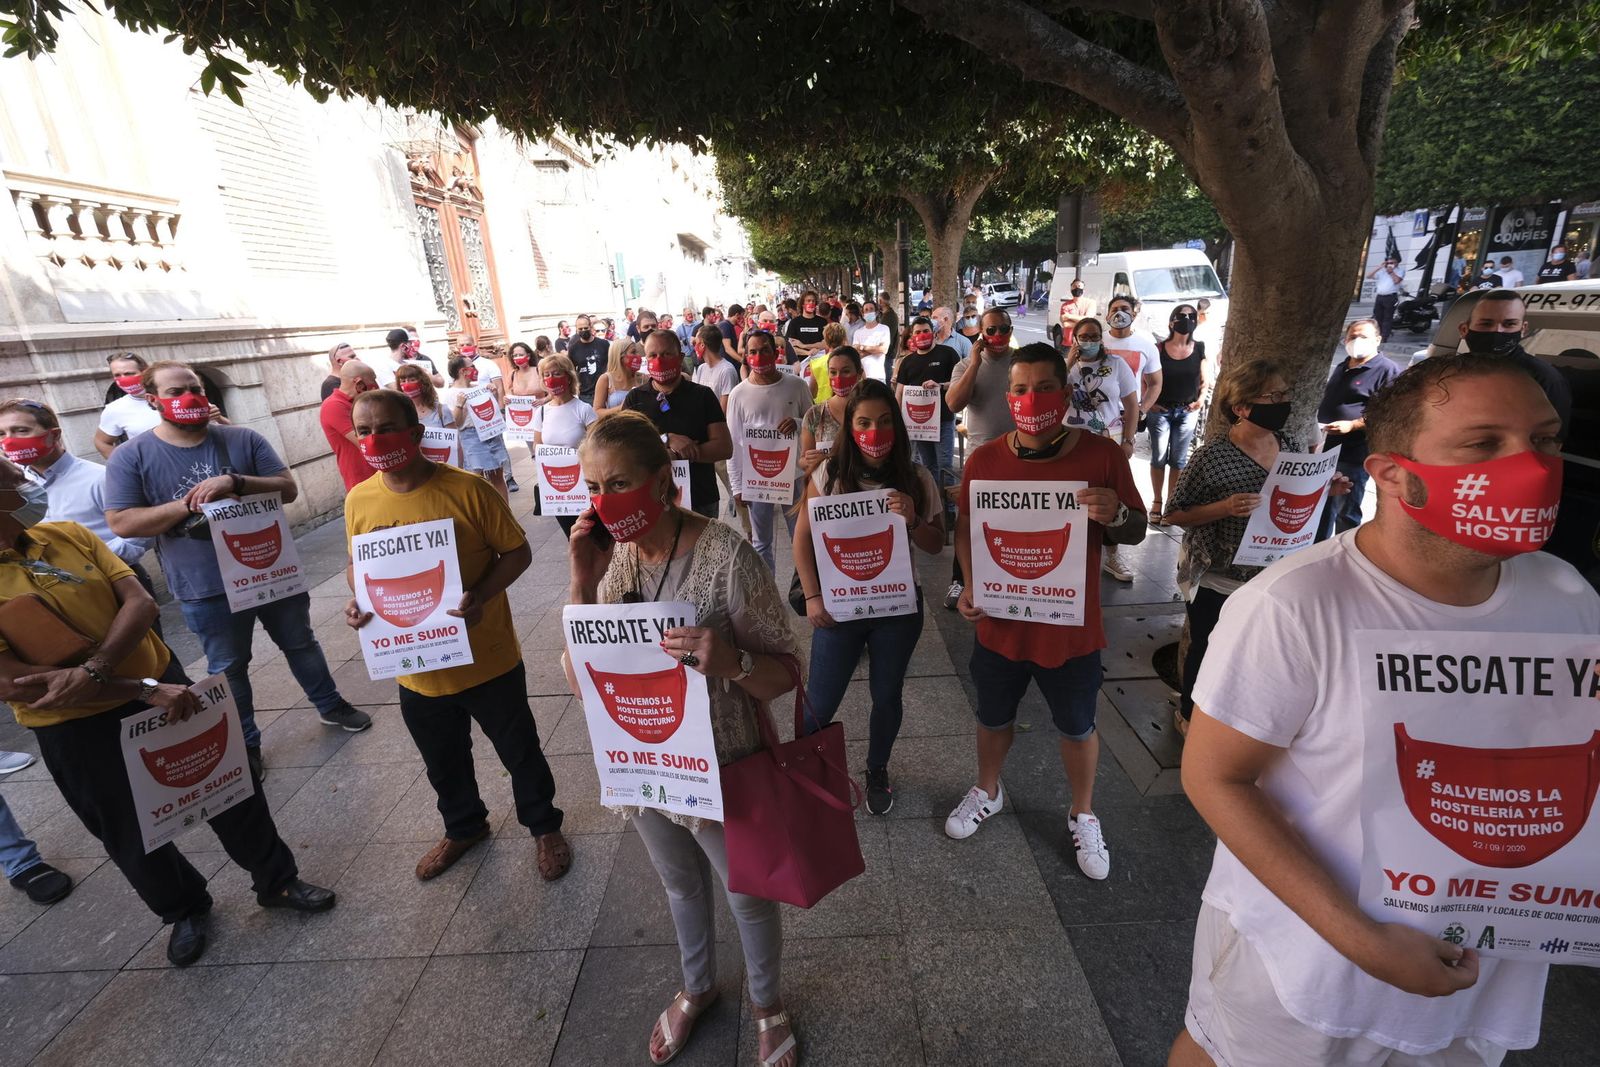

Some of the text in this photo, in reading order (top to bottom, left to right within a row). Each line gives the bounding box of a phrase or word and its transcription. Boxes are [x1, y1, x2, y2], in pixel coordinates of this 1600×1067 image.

[444, 432, 455, 441] YA!
[746, 429, 782, 440] ¡RESCATE
[538, 447, 571, 456] ¡RESCATE
[672, 467, 687, 478] YA!
[1276, 458, 1329, 476] ¡RESCATE
[770, 481, 790, 489] SUMO
[210, 498, 279, 521] ¡RESCATE YA!
[976, 492, 1050, 510] ¡RESCATE
[814, 500, 874, 521] ¡RESCATE
[358, 529, 449, 562] ¡RESCATE YA!
[1252, 532, 1313, 546] YO ME SUMO
[1001, 547, 1041, 555] SALVEMOS
[855, 561, 884, 571] NOCTURNO
[1001, 559, 1053, 568] OCIO NOCTURNO
[233, 578, 249, 588] YO
[252, 574, 268, 584] ME
[271, 565, 298, 579] SUMO
[384, 588, 433, 602] SALVEMOS LA
[830, 583, 907, 597] YO ME SUMO
[983, 582, 1076, 598] YO ME SUMO
[384, 601, 434, 616] OCIO NOCTURNO
[371, 638, 390, 650] YO
[394, 633, 415, 646] ME
[417, 625, 458, 642] SUMO
[570, 618, 653, 645] ¡RESCATE
[1376, 653, 1554, 697] ¡RESCATE
[204, 683, 227, 705] YA!
[615, 695, 672, 705] SALVEMOS LA
[659, 707, 665, 715] Y
[666, 706, 674, 714] EL
[618, 714, 676, 726] OCIO NOCTURNO
[164, 746, 208, 771] SALVEMOS
[606, 750, 709, 773] YO ME SUMO
[150, 766, 243, 819] YO ME SUMO
[1431, 781, 1562, 802] SALVEMOS LA
[1431, 797, 1562, 819] HOSTELERÍA Y EL
[1430, 812, 1564, 837] OCIO NOCTURNO
[1383, 868, 1600, 909] YO ME SUM
[1384, 897, 1429, 913] SALVEMOS
[1431, 905, 1440, 913] LA
[1441, 903, 1484, 913] HOSTELERÍA
[1486, 905, 1492, 913] Y
[1494, 906, 1530, 918] LOCALES
[1531, 910, 1541, 919] DE
[1544, 912, 1563, 921] OCIO
